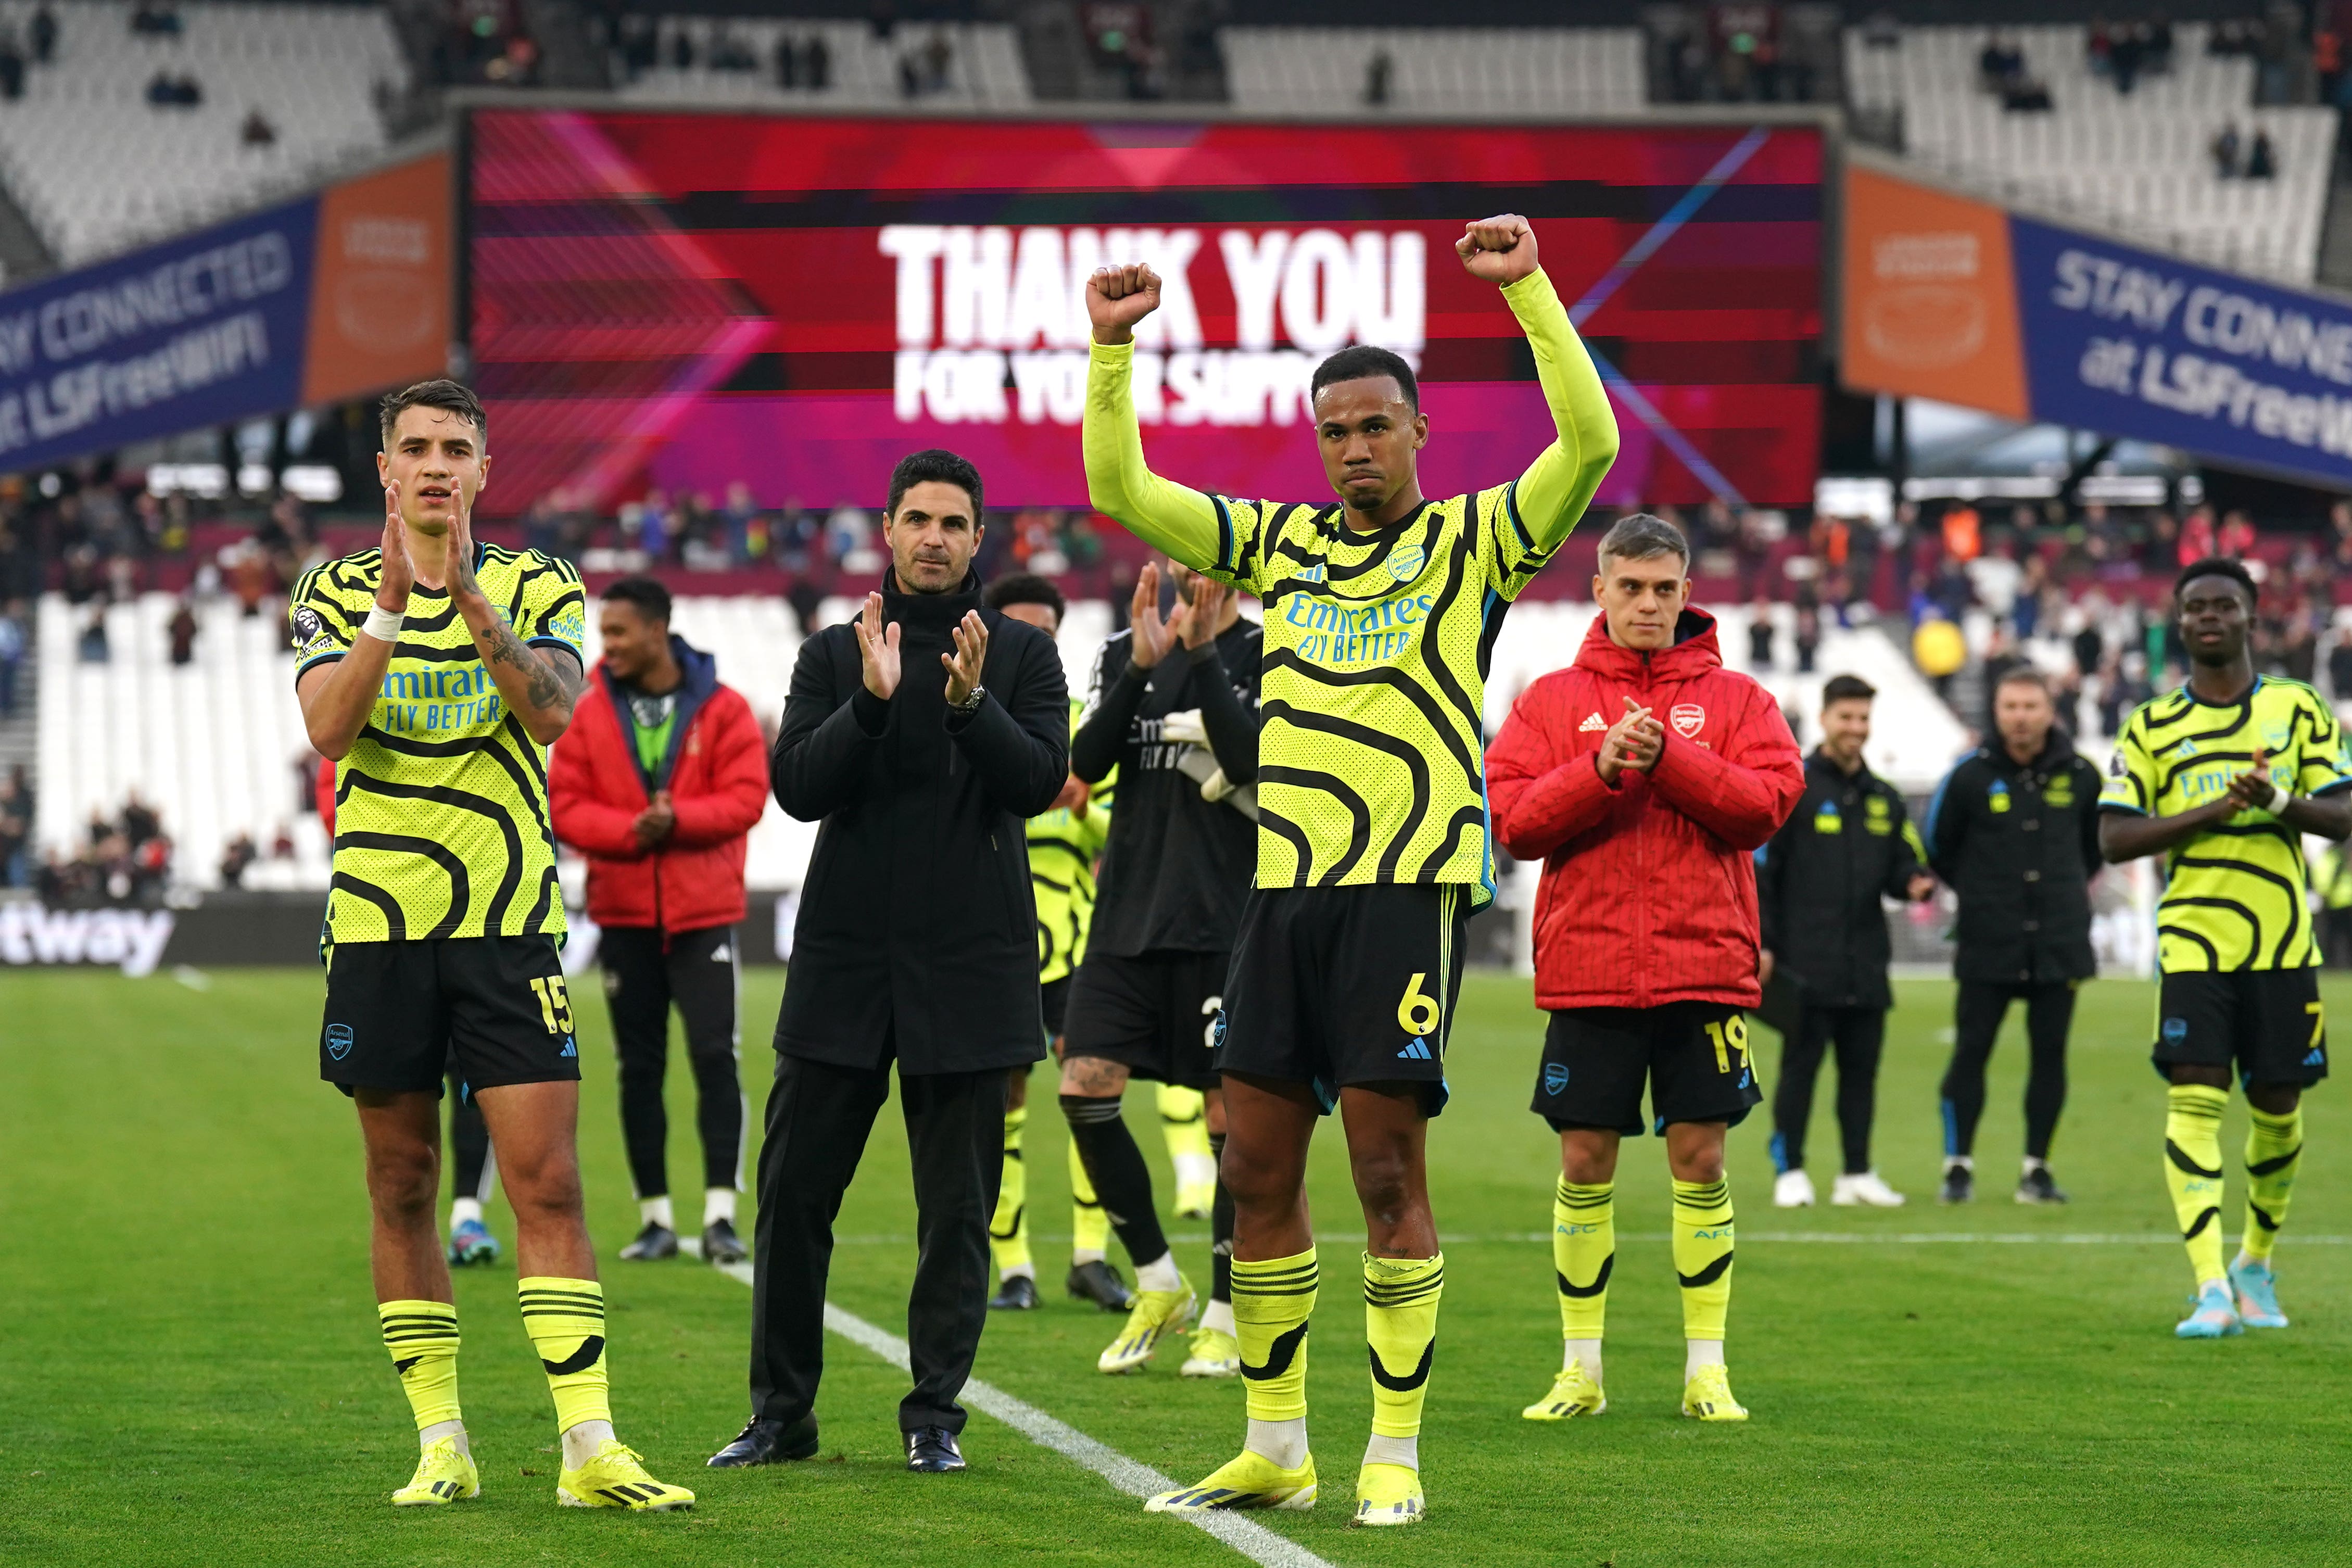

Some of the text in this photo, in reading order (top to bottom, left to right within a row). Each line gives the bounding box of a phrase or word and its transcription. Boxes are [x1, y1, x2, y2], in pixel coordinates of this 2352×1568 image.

[1217, 230, 1427, 351] YOU
[2051, 249, 2183, 332] STAY
[894, 350, 1009, 425] FOR
[1010, 350, 1165, 425] YOR
[2080, 336, 2137, 396] at
[1393, 550, 1419, 564] Arsenal
[1286, 593, 1433, 634] Emirates
[1297, 631, 1410, 662] FLY BETTER
[377, 663, 496, 699] mirat
[385, 695, 500, 732] FLY BETTER
[529, 976, 574, 1034] 15
[1398, 973, 1439, 1035] 6
[2305, 1002, 2323, 1048] 7
[1704, 1015, 1749, 1073] 19
[1557, 1224, 1596, 1236] AFC
[1694, 1227, 1734, 1240] AFC
